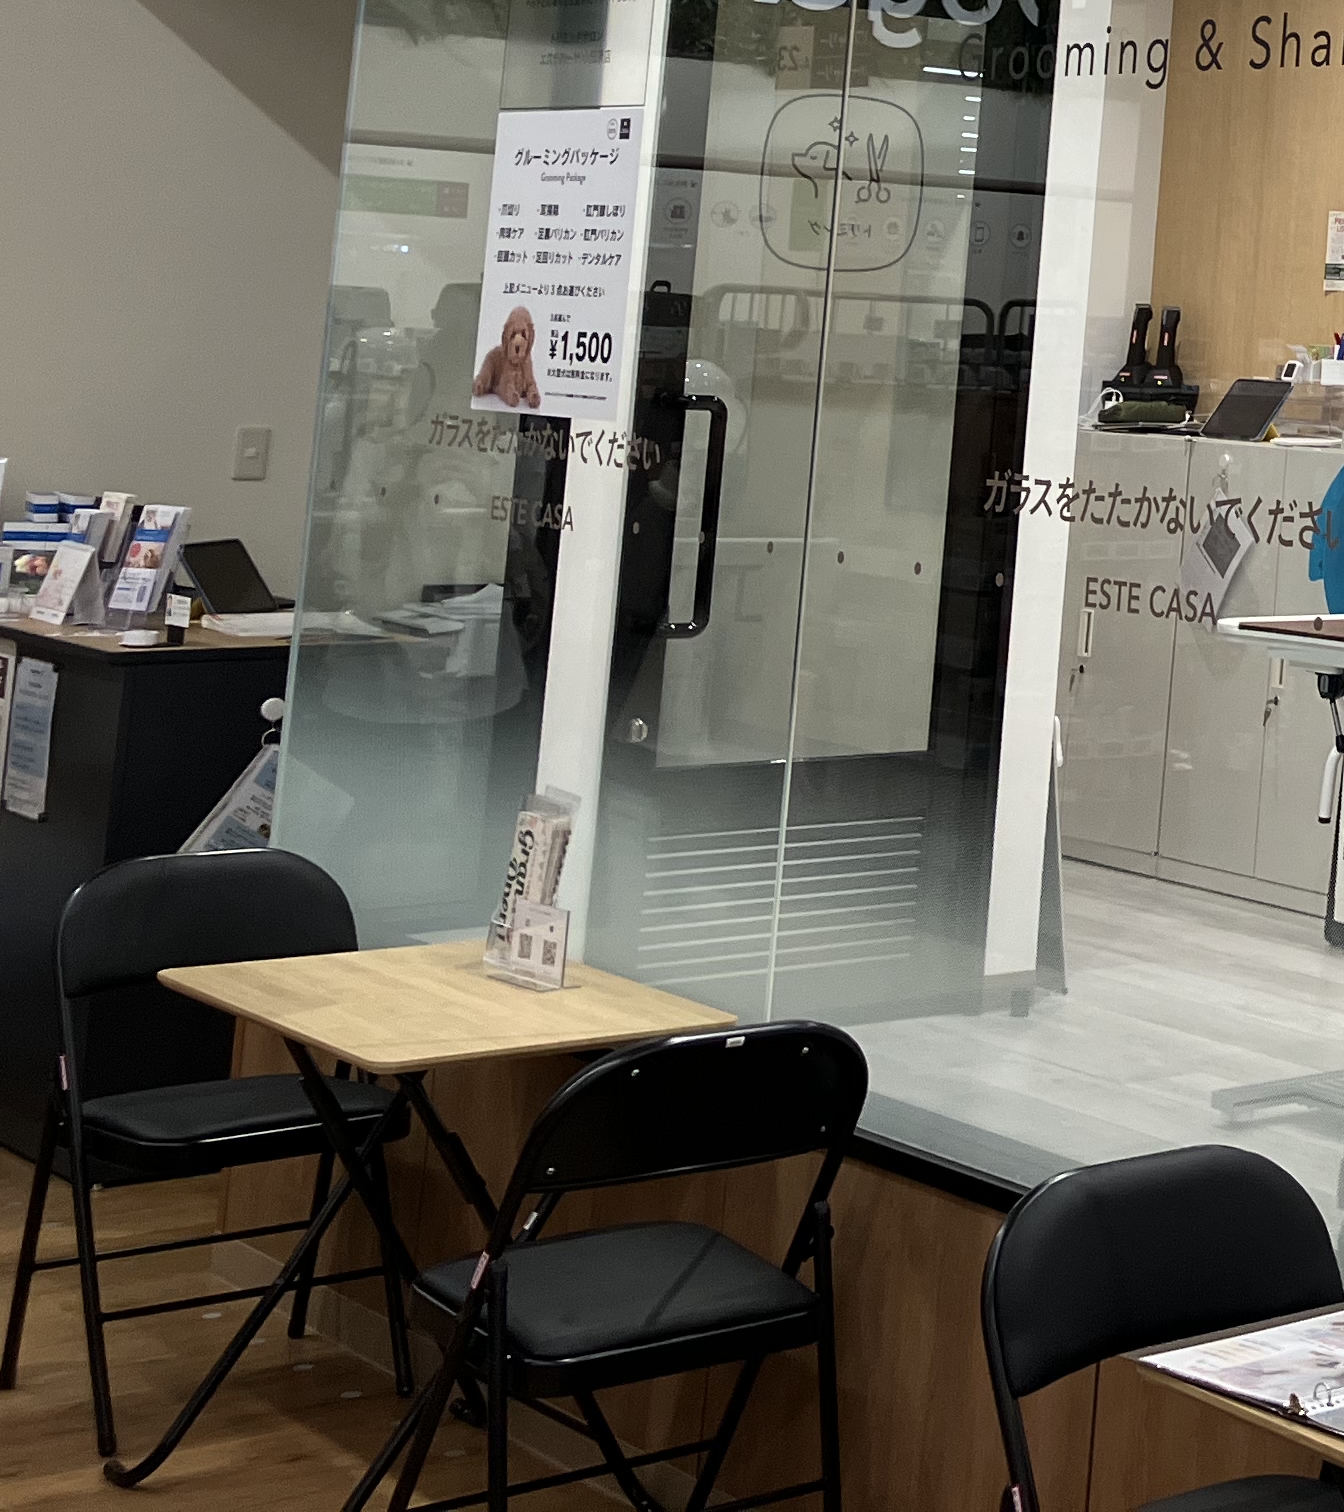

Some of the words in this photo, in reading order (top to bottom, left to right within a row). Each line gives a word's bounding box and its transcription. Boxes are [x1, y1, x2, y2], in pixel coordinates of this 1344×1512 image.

[960, 26, 1169, 88] Grooming
[1195, 19, 1224, 72] &
[514, 147, 620, 166] グルーミングパッケージ
[541, 172, 565, 185] Grooming
[566, 172, 586, 185] Package
[549, 330, 613, 366] ¥1,500
[428, 412, 660, 471] ガラスをたたかないでください
[491, 496, 528, 525] ESTE
[533, 500, 574, 531] CASA
[1085, 577, 1140, 614] ESTE
[1149, 586, 1218, 625] CASA
